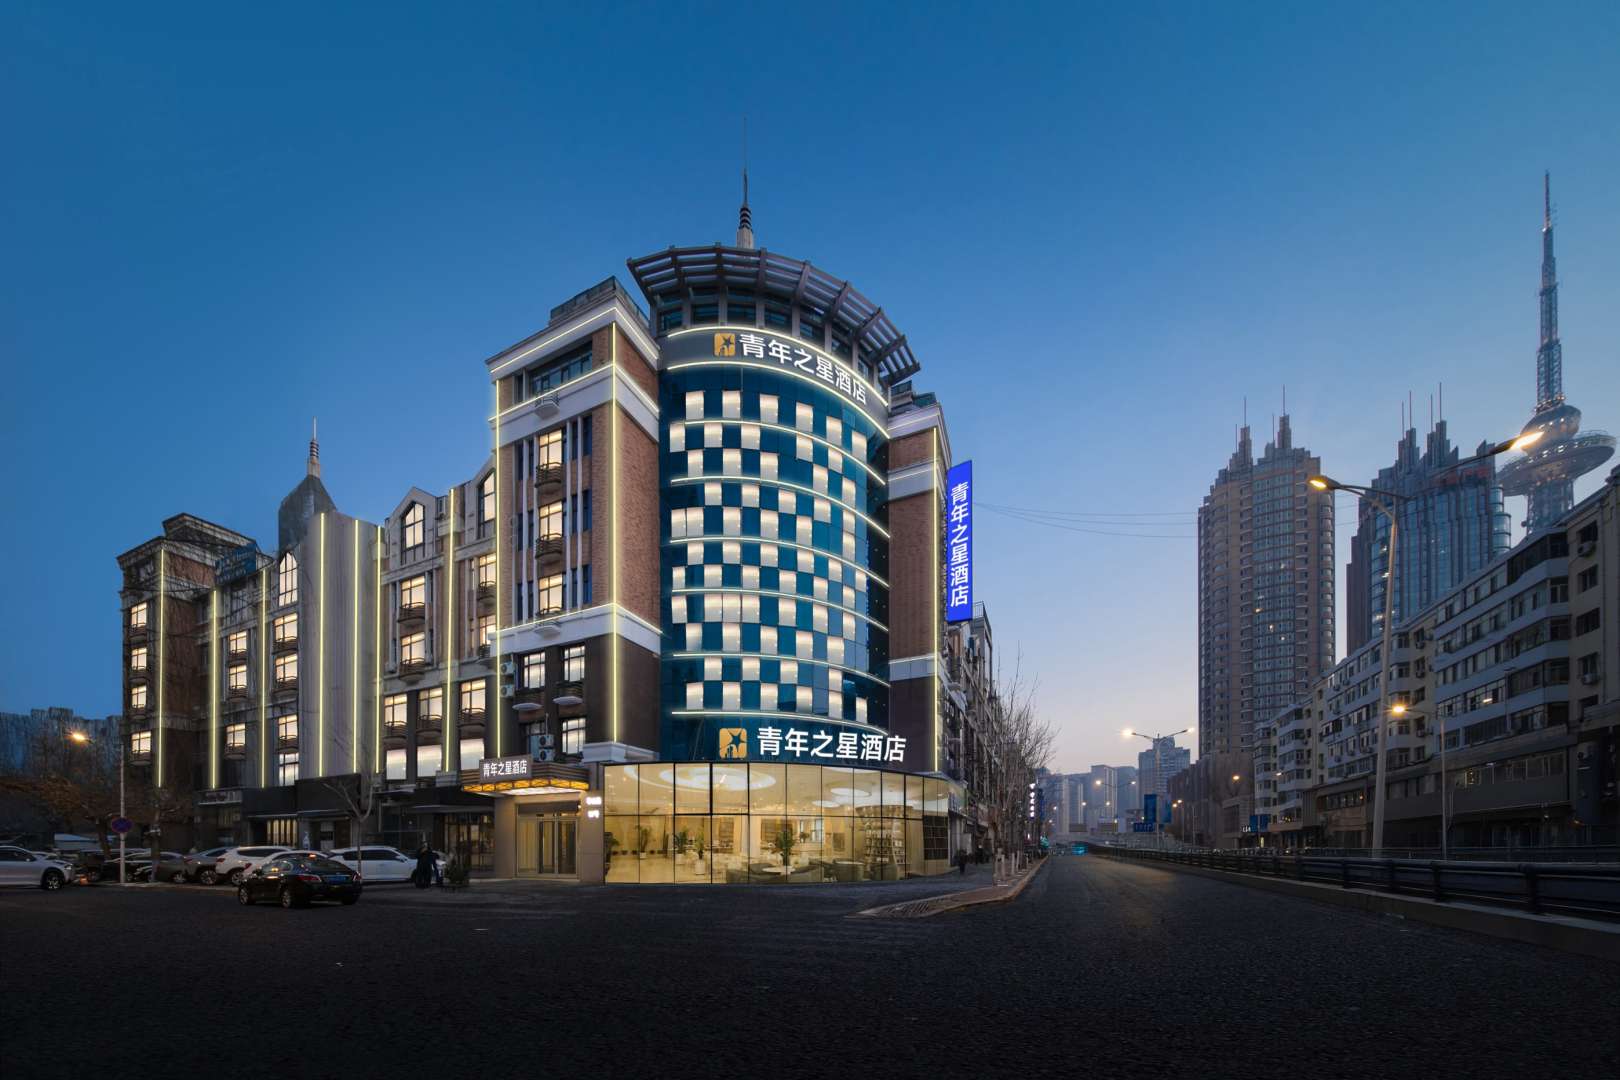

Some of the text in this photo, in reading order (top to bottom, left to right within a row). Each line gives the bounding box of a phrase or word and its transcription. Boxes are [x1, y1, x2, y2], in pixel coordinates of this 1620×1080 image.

[739, 334, 868, 405] 青年之星酒店
[950, 481, 969, 607] 青年之星酒店
[483, 760, 528, 777] 青年之星酒店
[757, 726, 907, 762] 青年之星酒店
